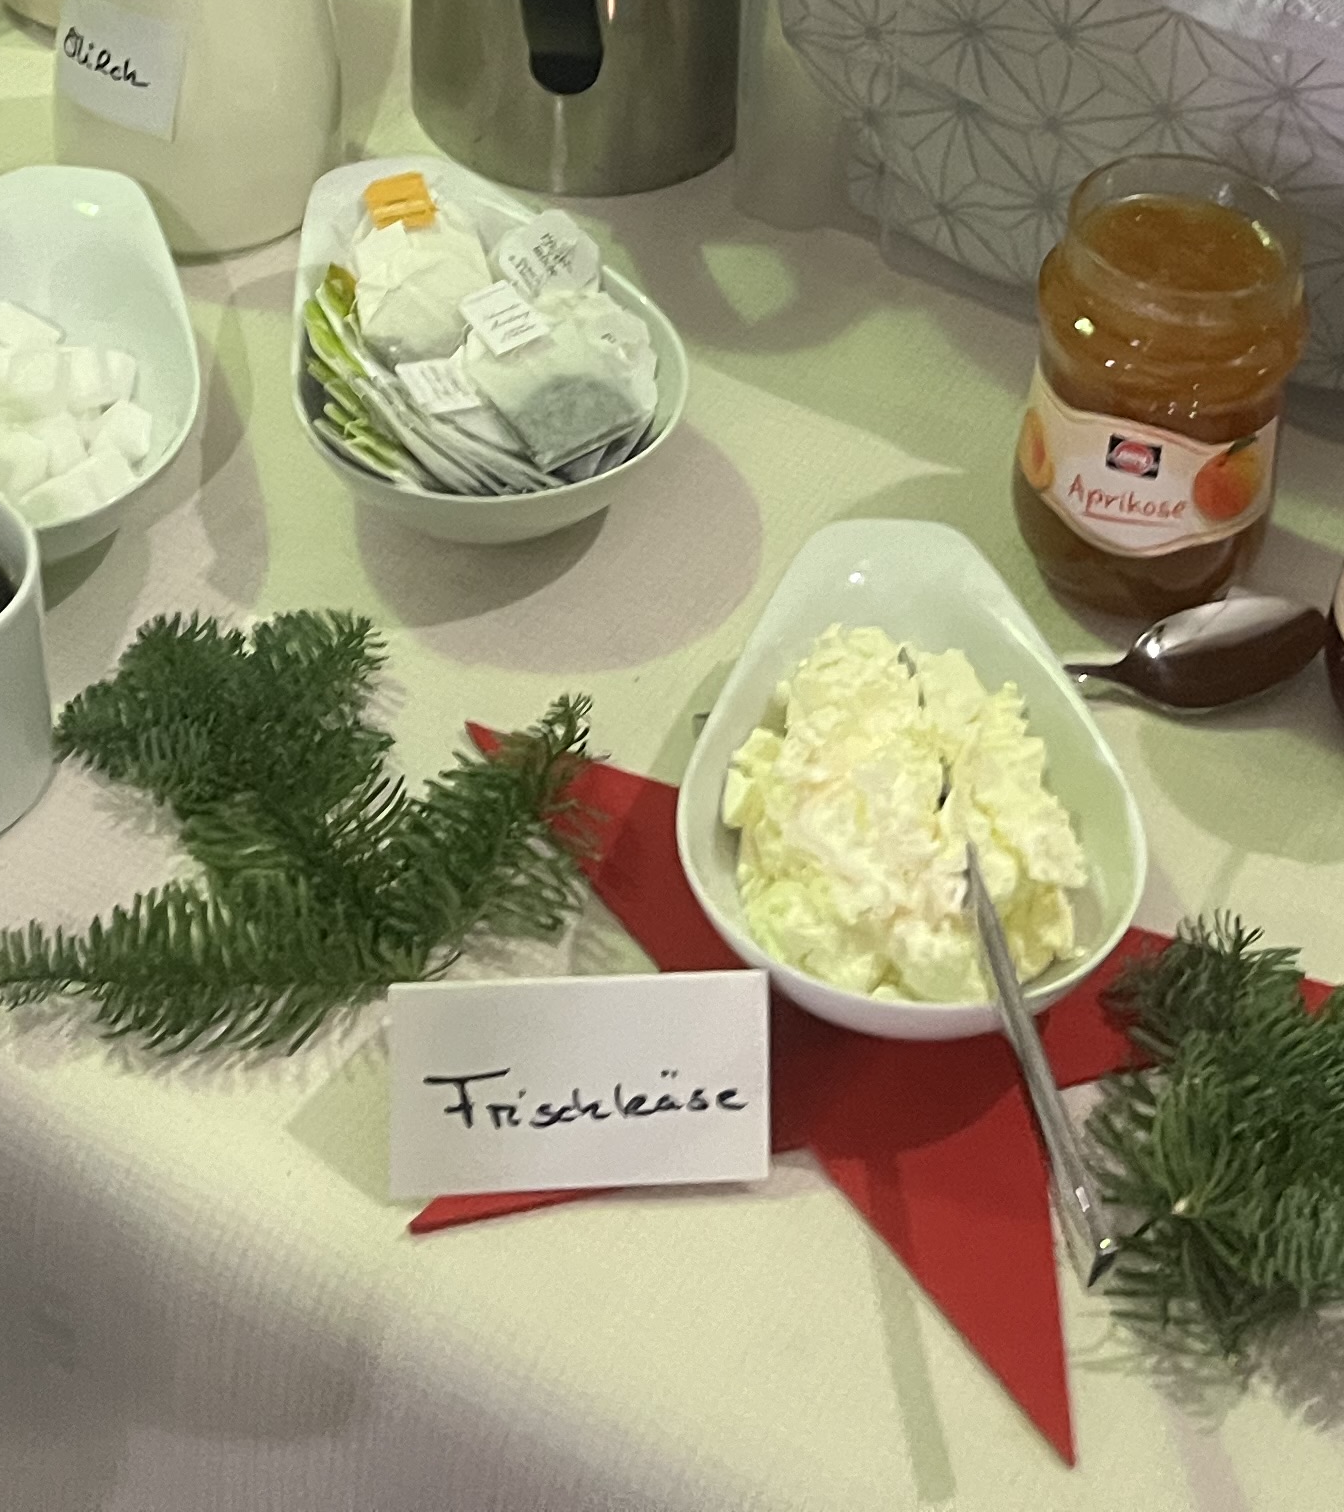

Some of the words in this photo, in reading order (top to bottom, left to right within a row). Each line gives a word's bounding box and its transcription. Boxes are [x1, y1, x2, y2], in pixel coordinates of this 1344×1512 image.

[64, 26, 151, 88] Milch
[1067, 475, 1191, 522] Aprikose
[423, 1067, 749, 1131] Frischkäse
